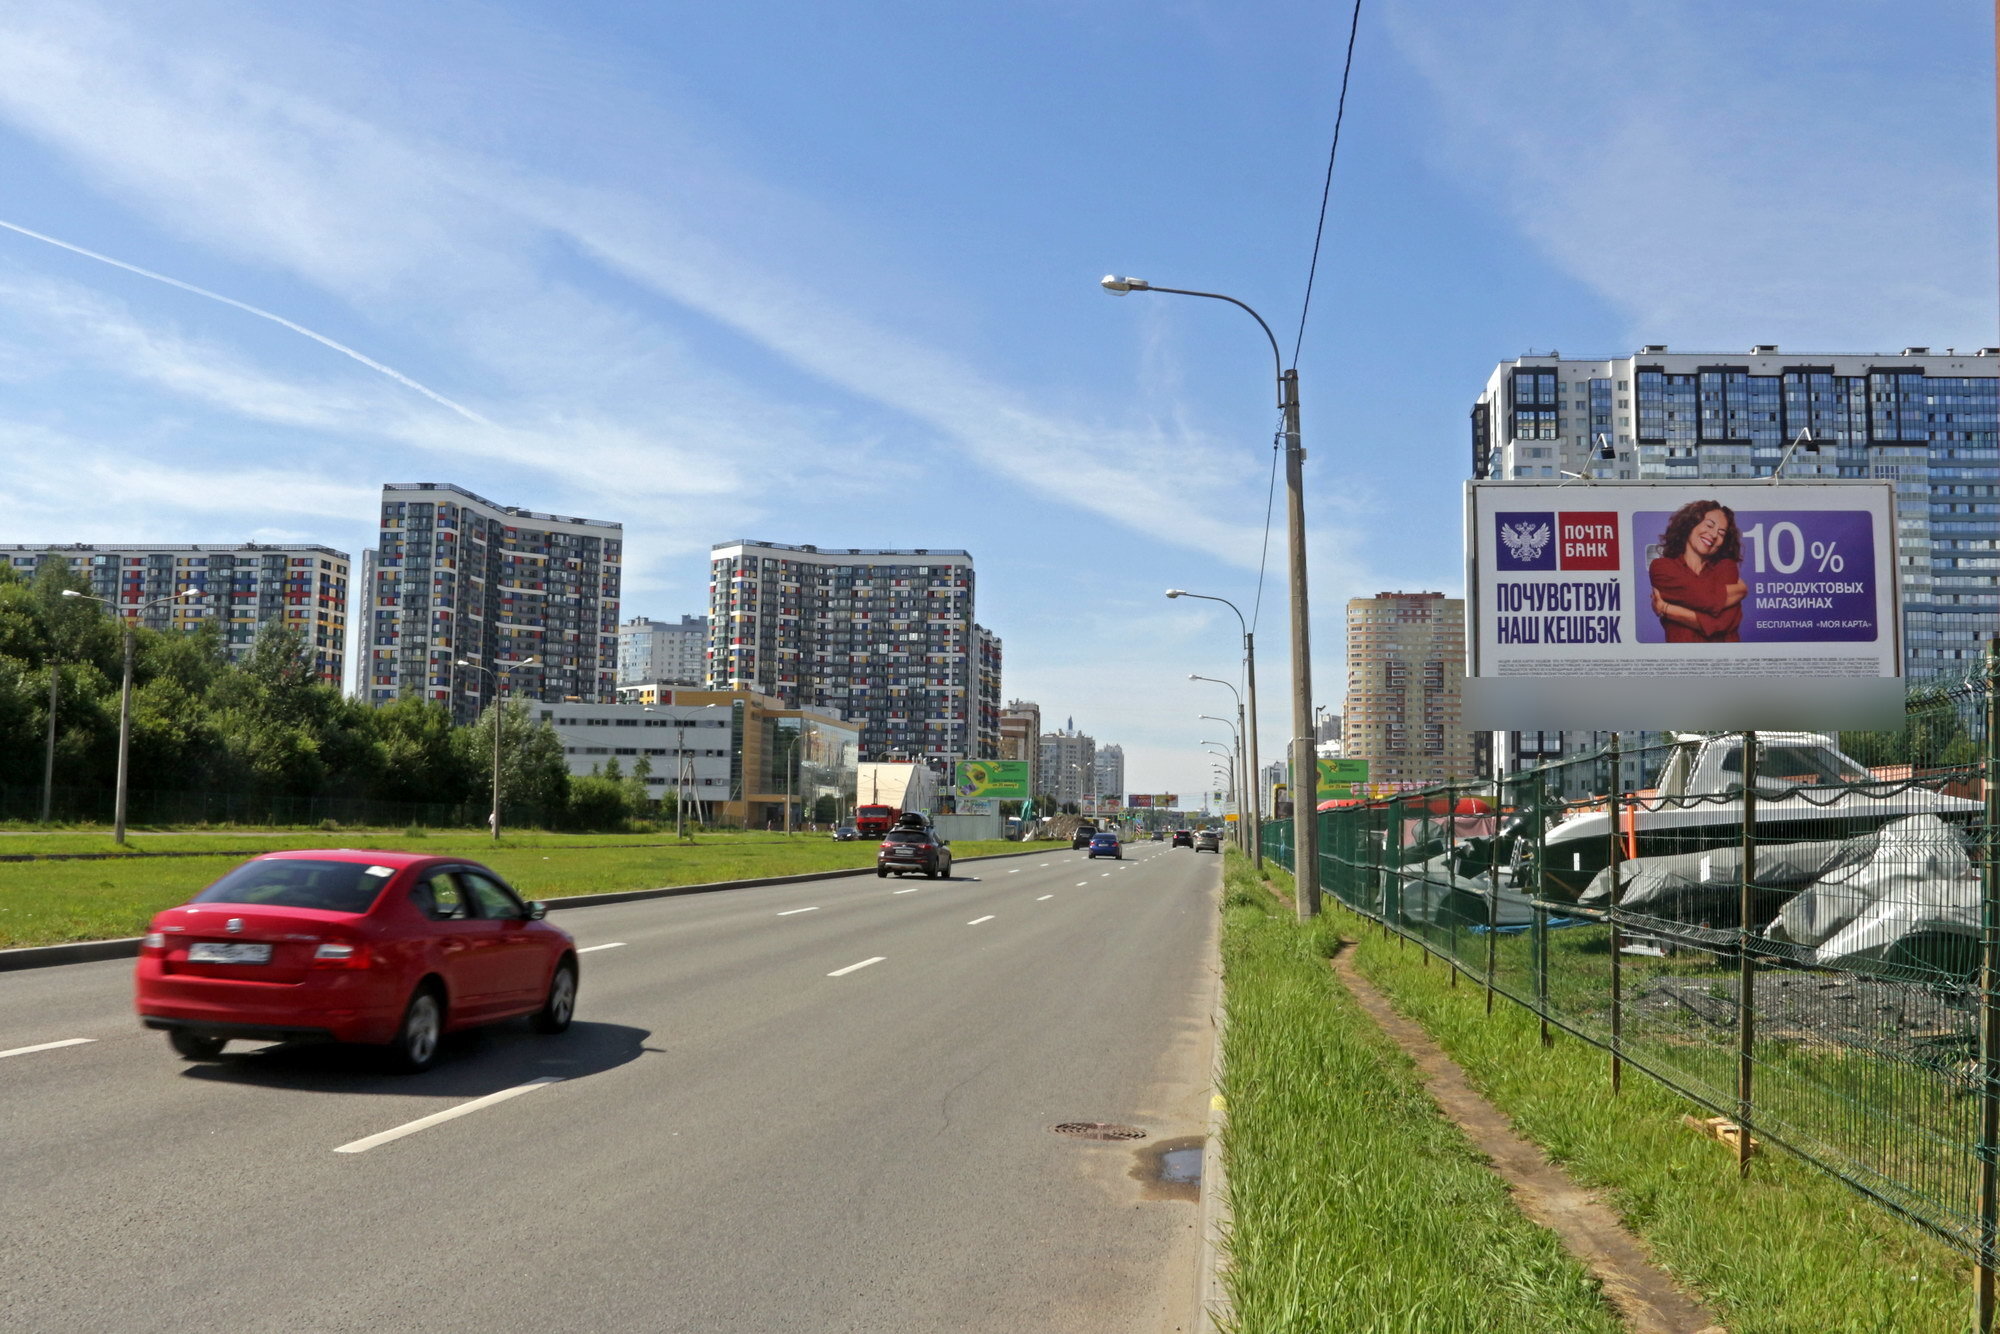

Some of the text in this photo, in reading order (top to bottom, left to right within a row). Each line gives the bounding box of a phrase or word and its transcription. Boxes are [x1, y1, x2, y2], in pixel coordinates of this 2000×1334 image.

[1564, 524, 1614, 540] ПОЧТА
[1565, 542, 1608, 558] БАНК
[1496, 577, 1621, 612] ПОЧУВСТВУЙ
[1755, 581, 1864, 596] В ПРОДУКТОВЫХ
[1755, 596, 1834, 609] МАГАЗИНАХ
[1497, 615, 1622, 645] НАШ КЕШБЭК
[1756, 620, 1813, 629] БЕСПЛАТНАЯ
